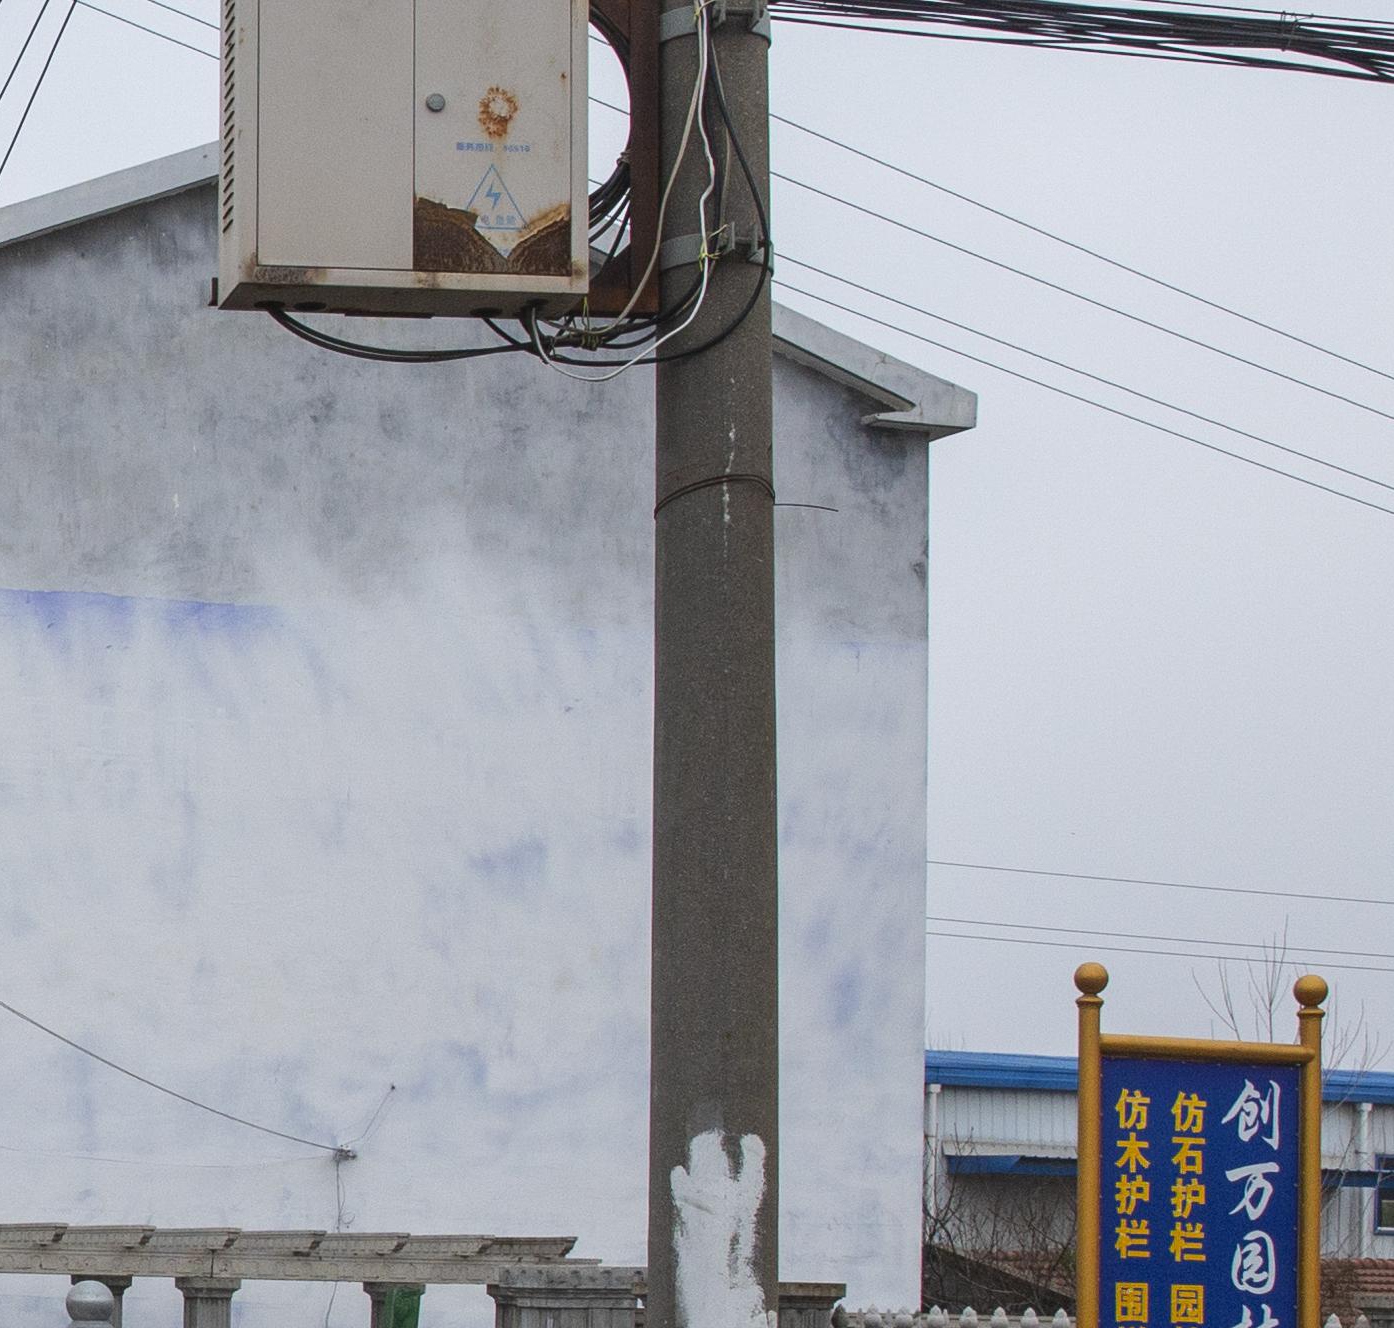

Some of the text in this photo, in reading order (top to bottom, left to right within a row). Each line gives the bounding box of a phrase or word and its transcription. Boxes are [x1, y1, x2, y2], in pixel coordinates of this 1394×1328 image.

[1114, 1089, 1150, 1259] 仿木护栏
[1170, 1092, 1207, 1263] 仿石护栏
